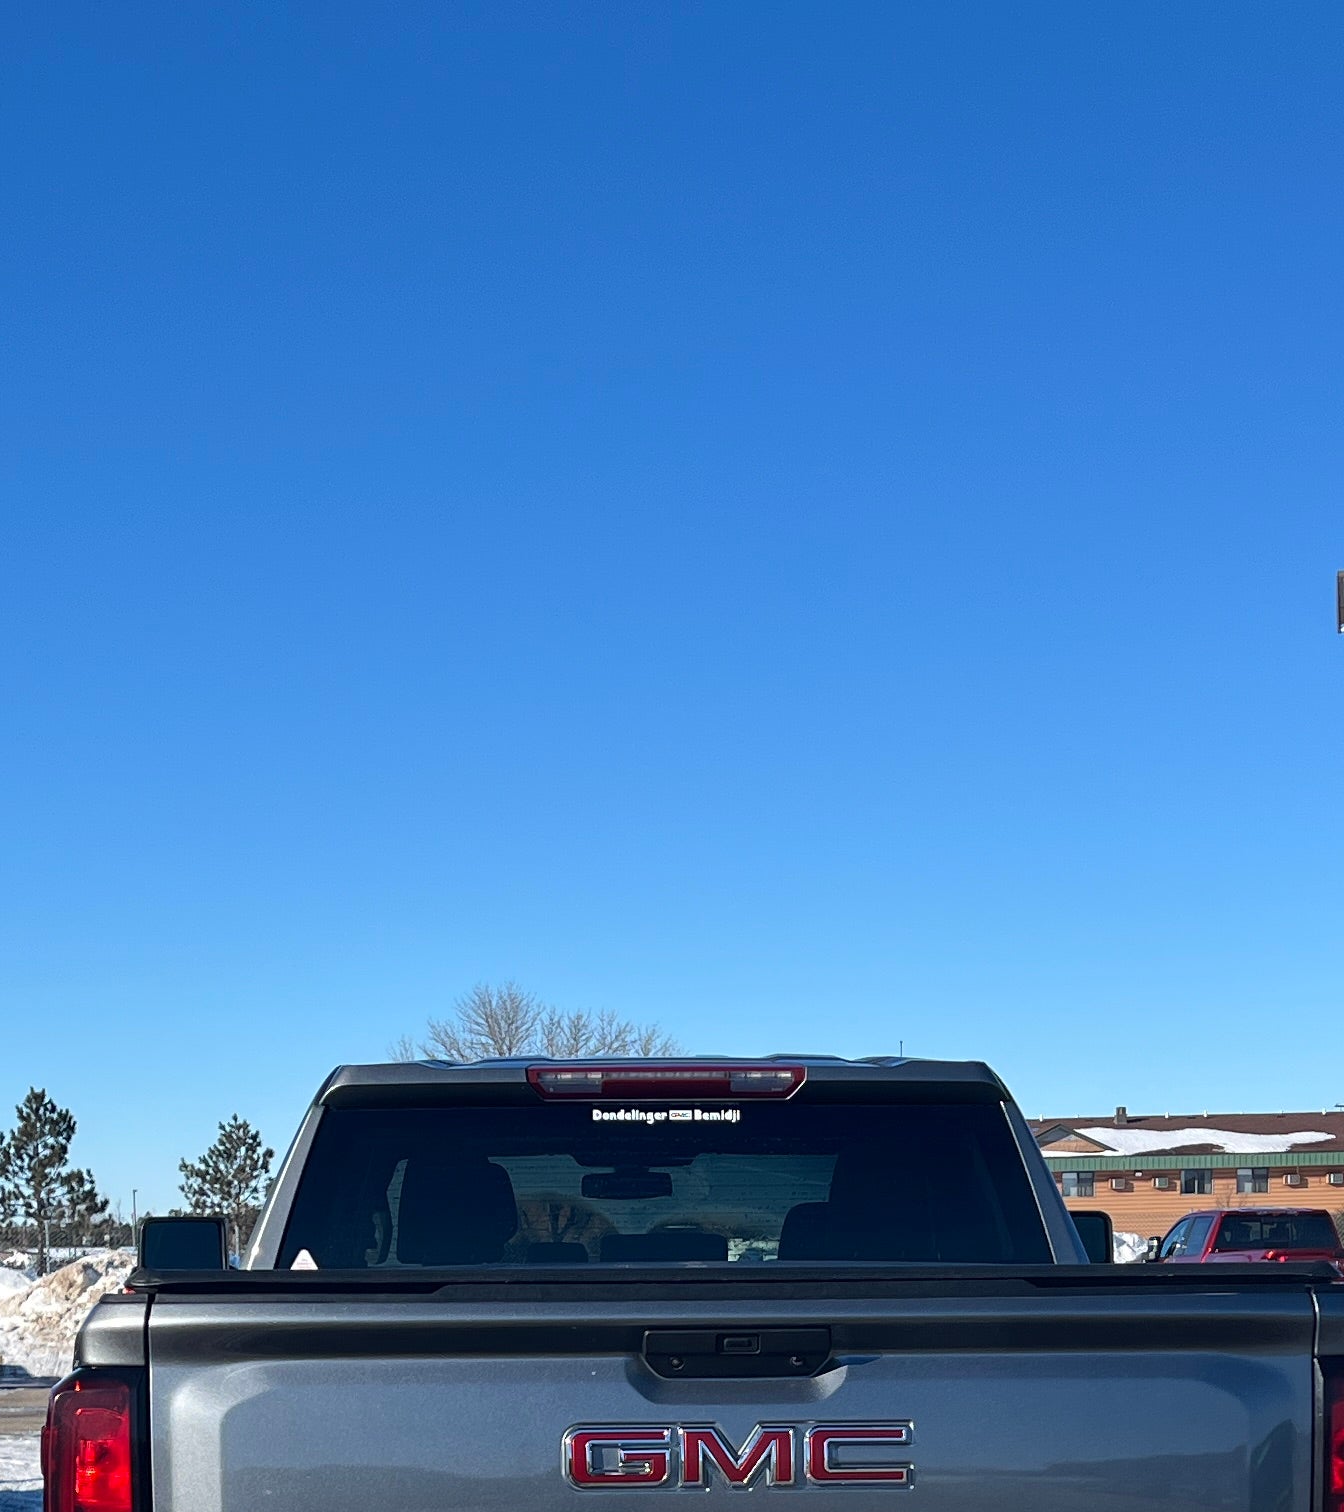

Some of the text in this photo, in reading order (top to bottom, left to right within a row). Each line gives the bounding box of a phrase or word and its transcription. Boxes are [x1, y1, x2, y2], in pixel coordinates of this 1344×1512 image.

[592, 1109, 668, 1124] Dondelinger
[694, 1109, 741, 1123] Bemidji
[561, 1419, 914, 1492] GMC
